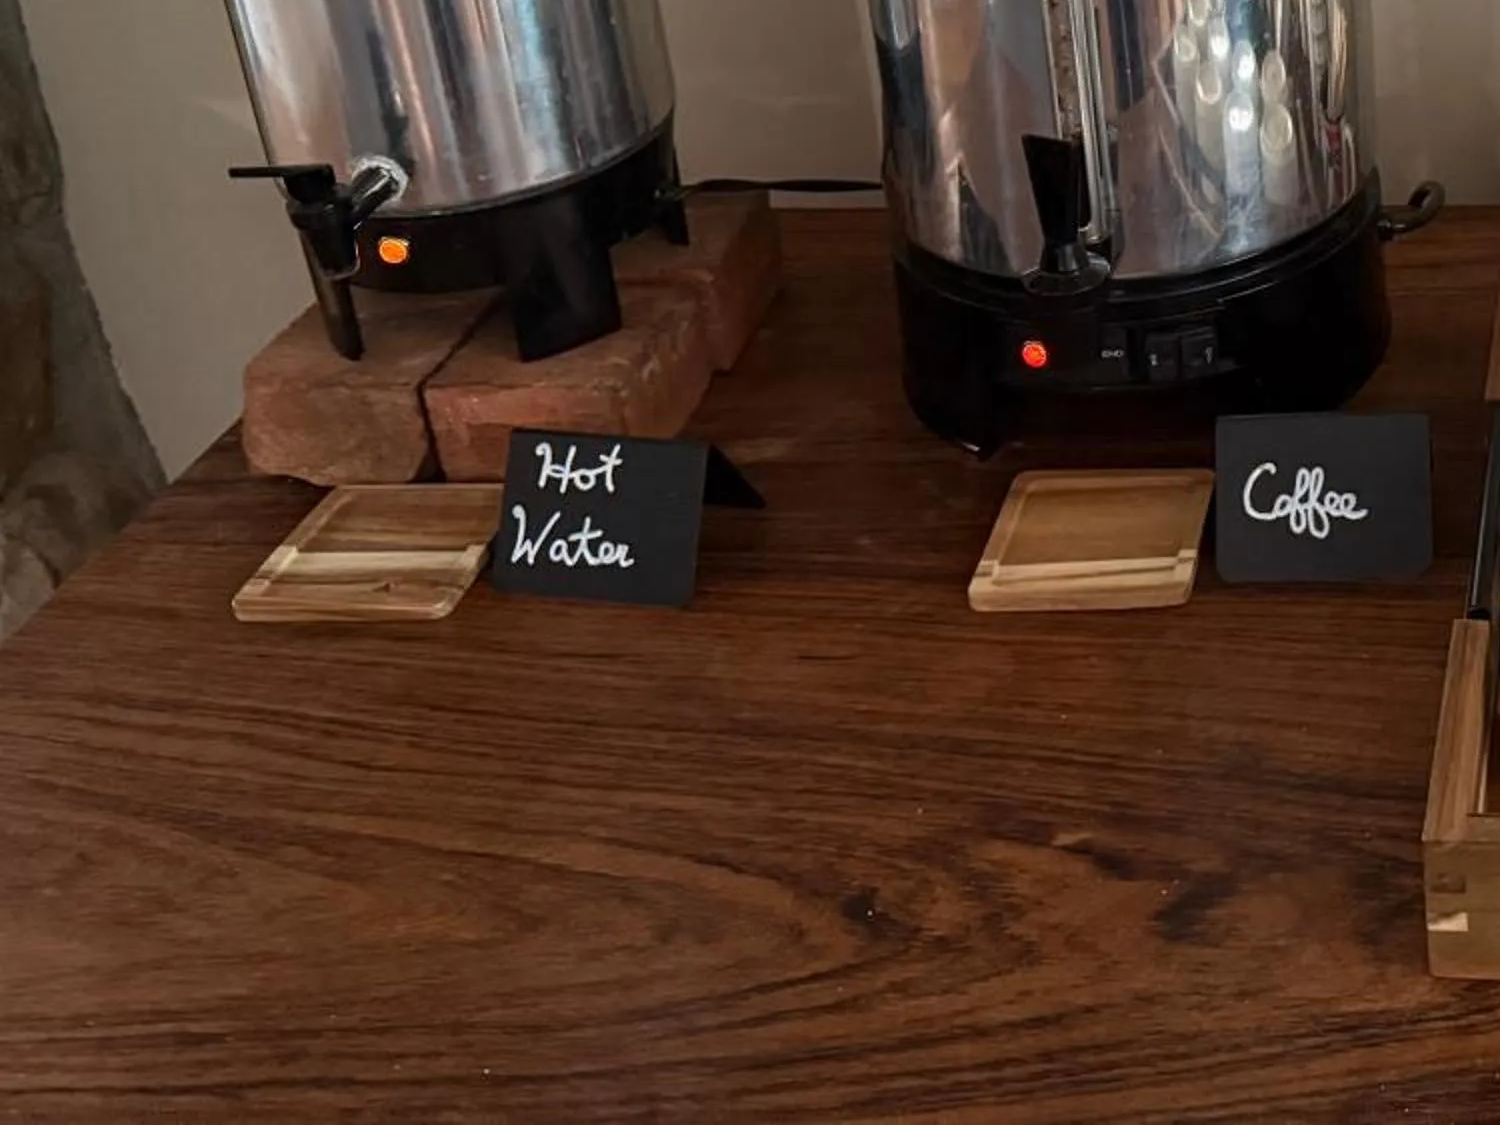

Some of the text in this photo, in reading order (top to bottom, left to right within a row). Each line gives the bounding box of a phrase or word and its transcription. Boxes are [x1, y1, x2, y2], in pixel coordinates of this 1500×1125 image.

[535, 442, 623, 494] Hot
[1243, 462, 1369, 540] Coffee
[511, 504, 635, 568] Water
